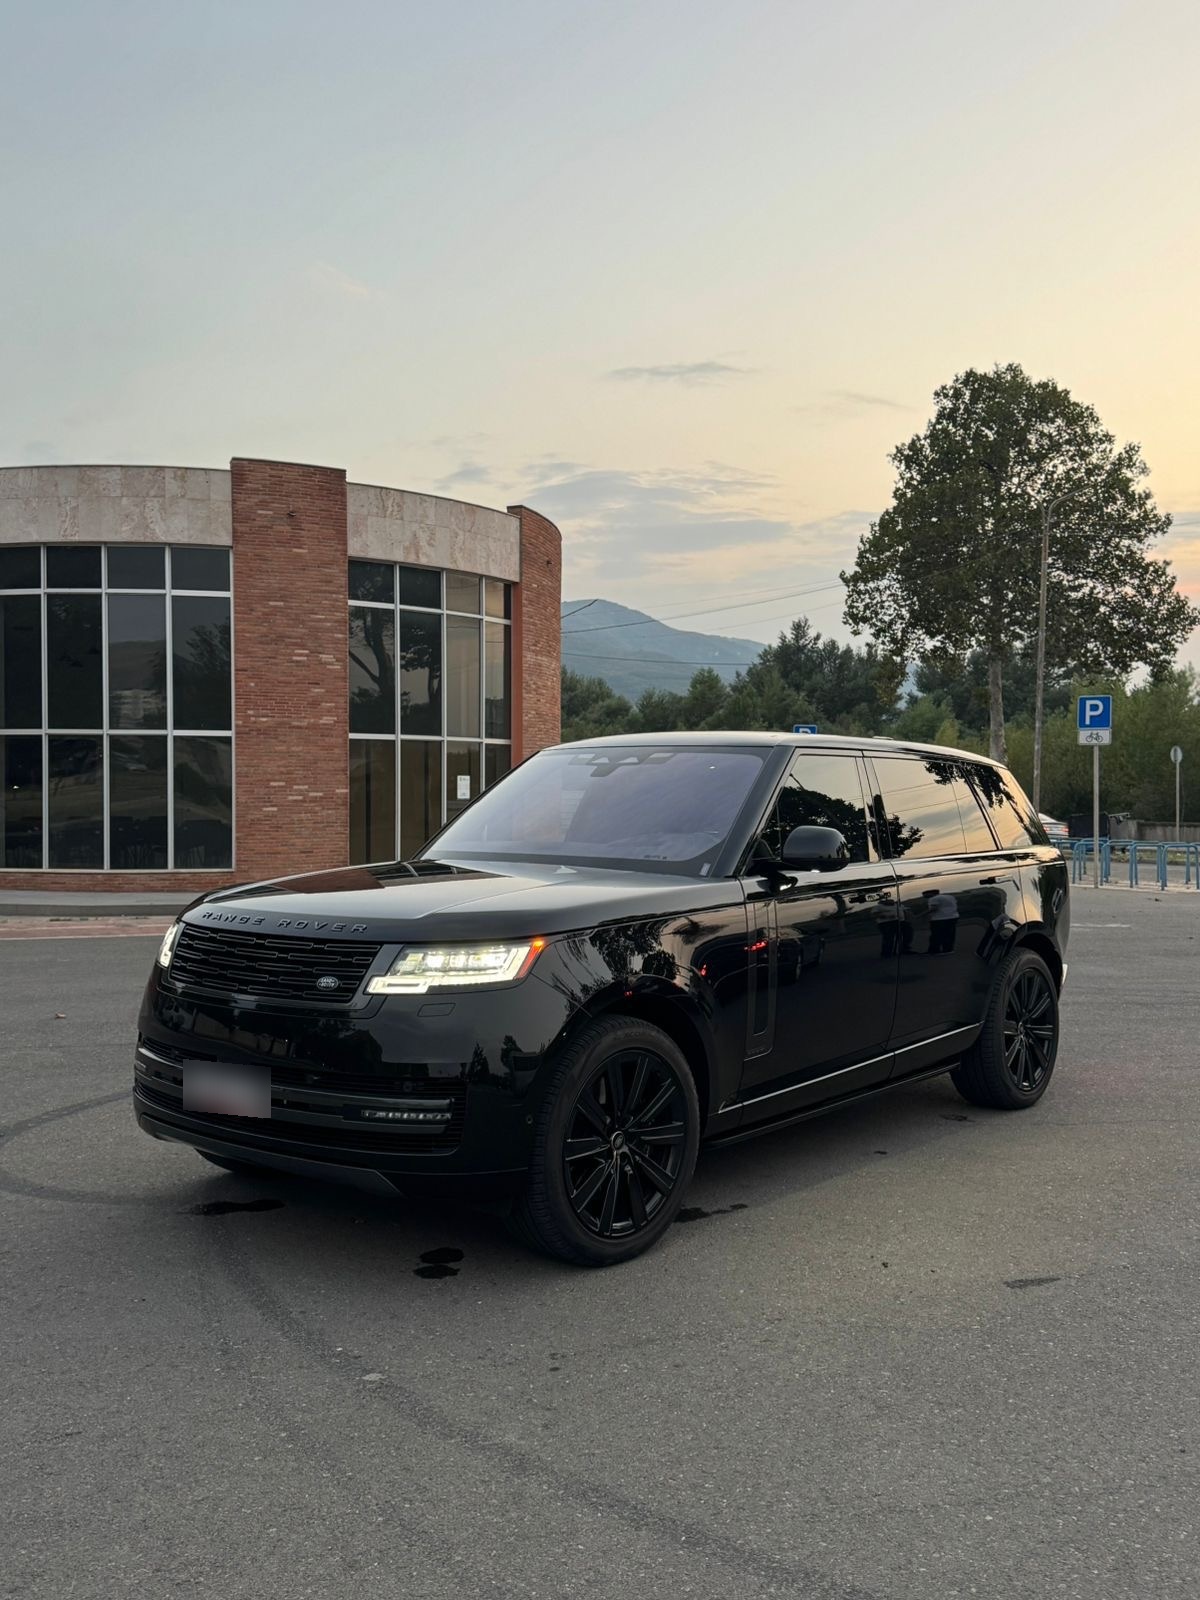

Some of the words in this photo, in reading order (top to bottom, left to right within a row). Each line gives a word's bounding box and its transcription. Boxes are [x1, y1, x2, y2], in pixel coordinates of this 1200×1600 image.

[1085, 699, 1104, 725] P
[202, 911, 266, 925] RANGE
[277, 918, 368, 933] ROVER
